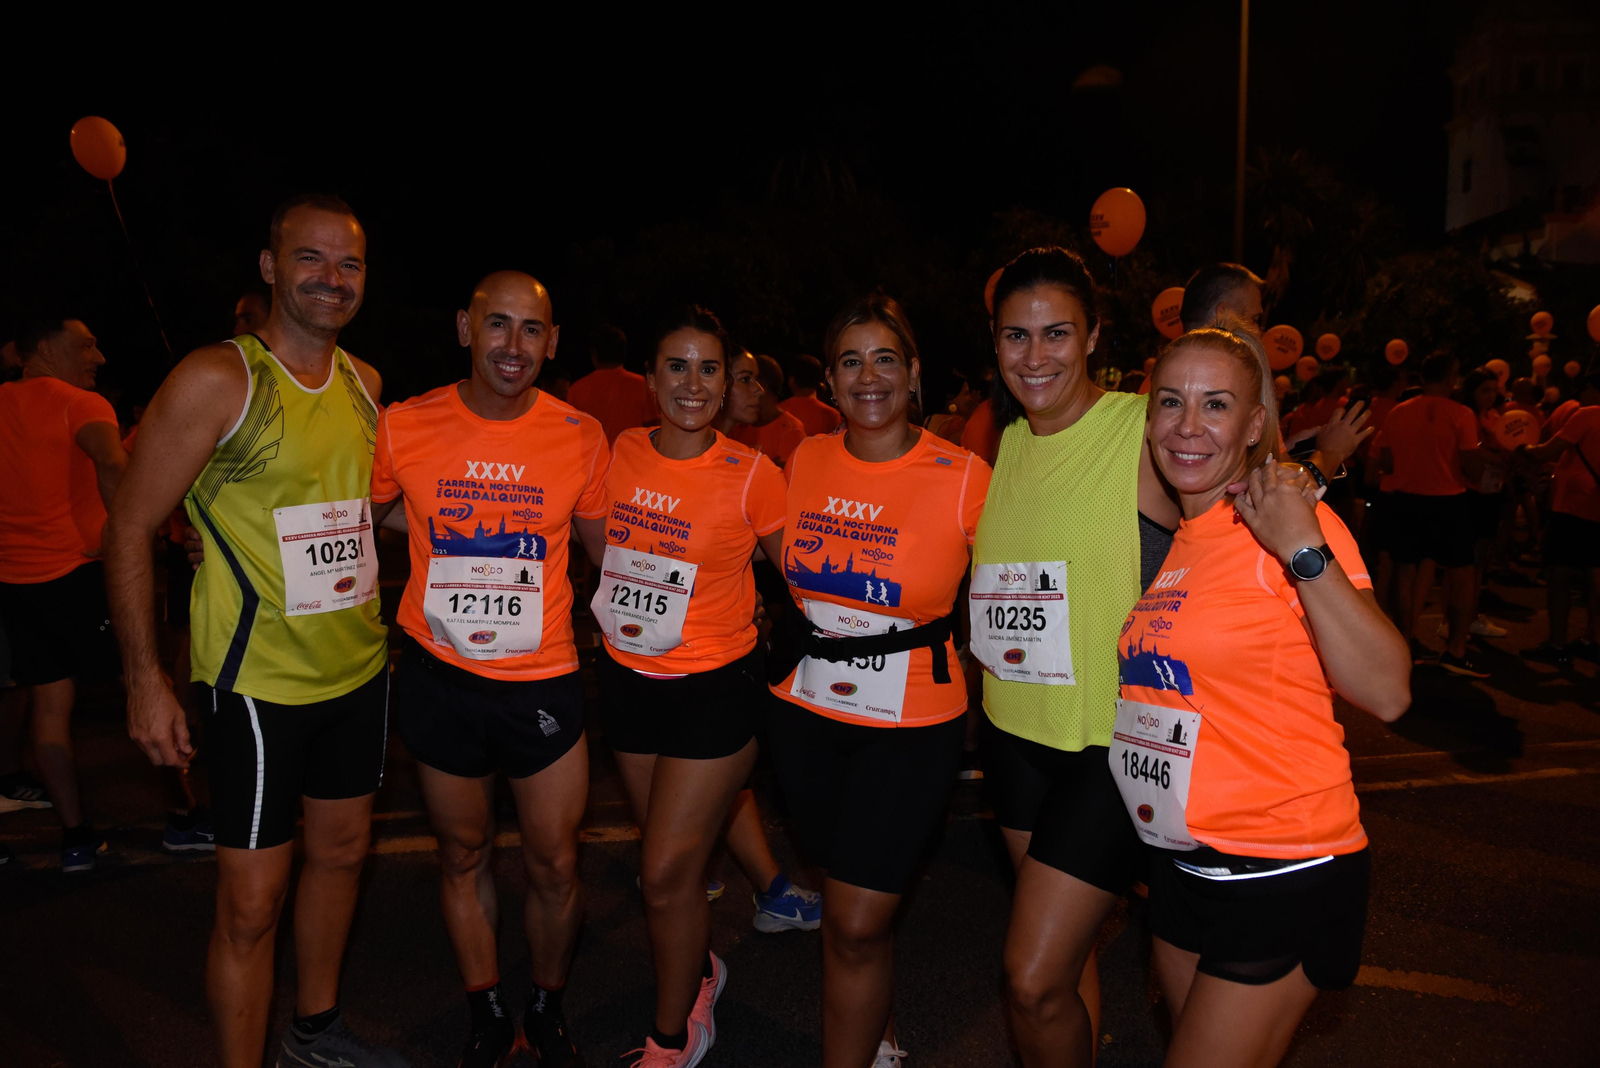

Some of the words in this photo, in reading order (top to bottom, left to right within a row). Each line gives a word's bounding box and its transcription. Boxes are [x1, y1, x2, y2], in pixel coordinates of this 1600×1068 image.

[464, 460, 526, 482] XXXV
[438, 479, 485, 490] CARRERA
[489, 483, 544, 494] NOCTURNA
[443, 488, 544, 505] GUADALQUIVIR
[630, 486, 681, 514] XXXV
[822, 495, 884, 522] XXXV
[613, 500, 643, 516] CARRERA
[646, 511, 692, 530] NOCTURNA
[614, 510, 690, 541] GUADALQUIVIR
[800, 510, 839, 525] CARRERA
[843, 520, 899, 535] NOCTURNA
[801, 520, 897, 547] GUADALQUIVIR
[306, 537, 364, 566] 10231
[1153, 567, 1191, 591] XXXV
[449, 593, 522, 616] 12116
[611, 584, 668, 615] 12115
[986, 605, 1047, 632] 10235
[1023, 635, 1042, 643] MARTÍN
[1038, 670, 1068, 678] Cruzcampo
[865, 704, 896, 715] Cruzcampo
[1122, 749, 1171, 790] 18446
